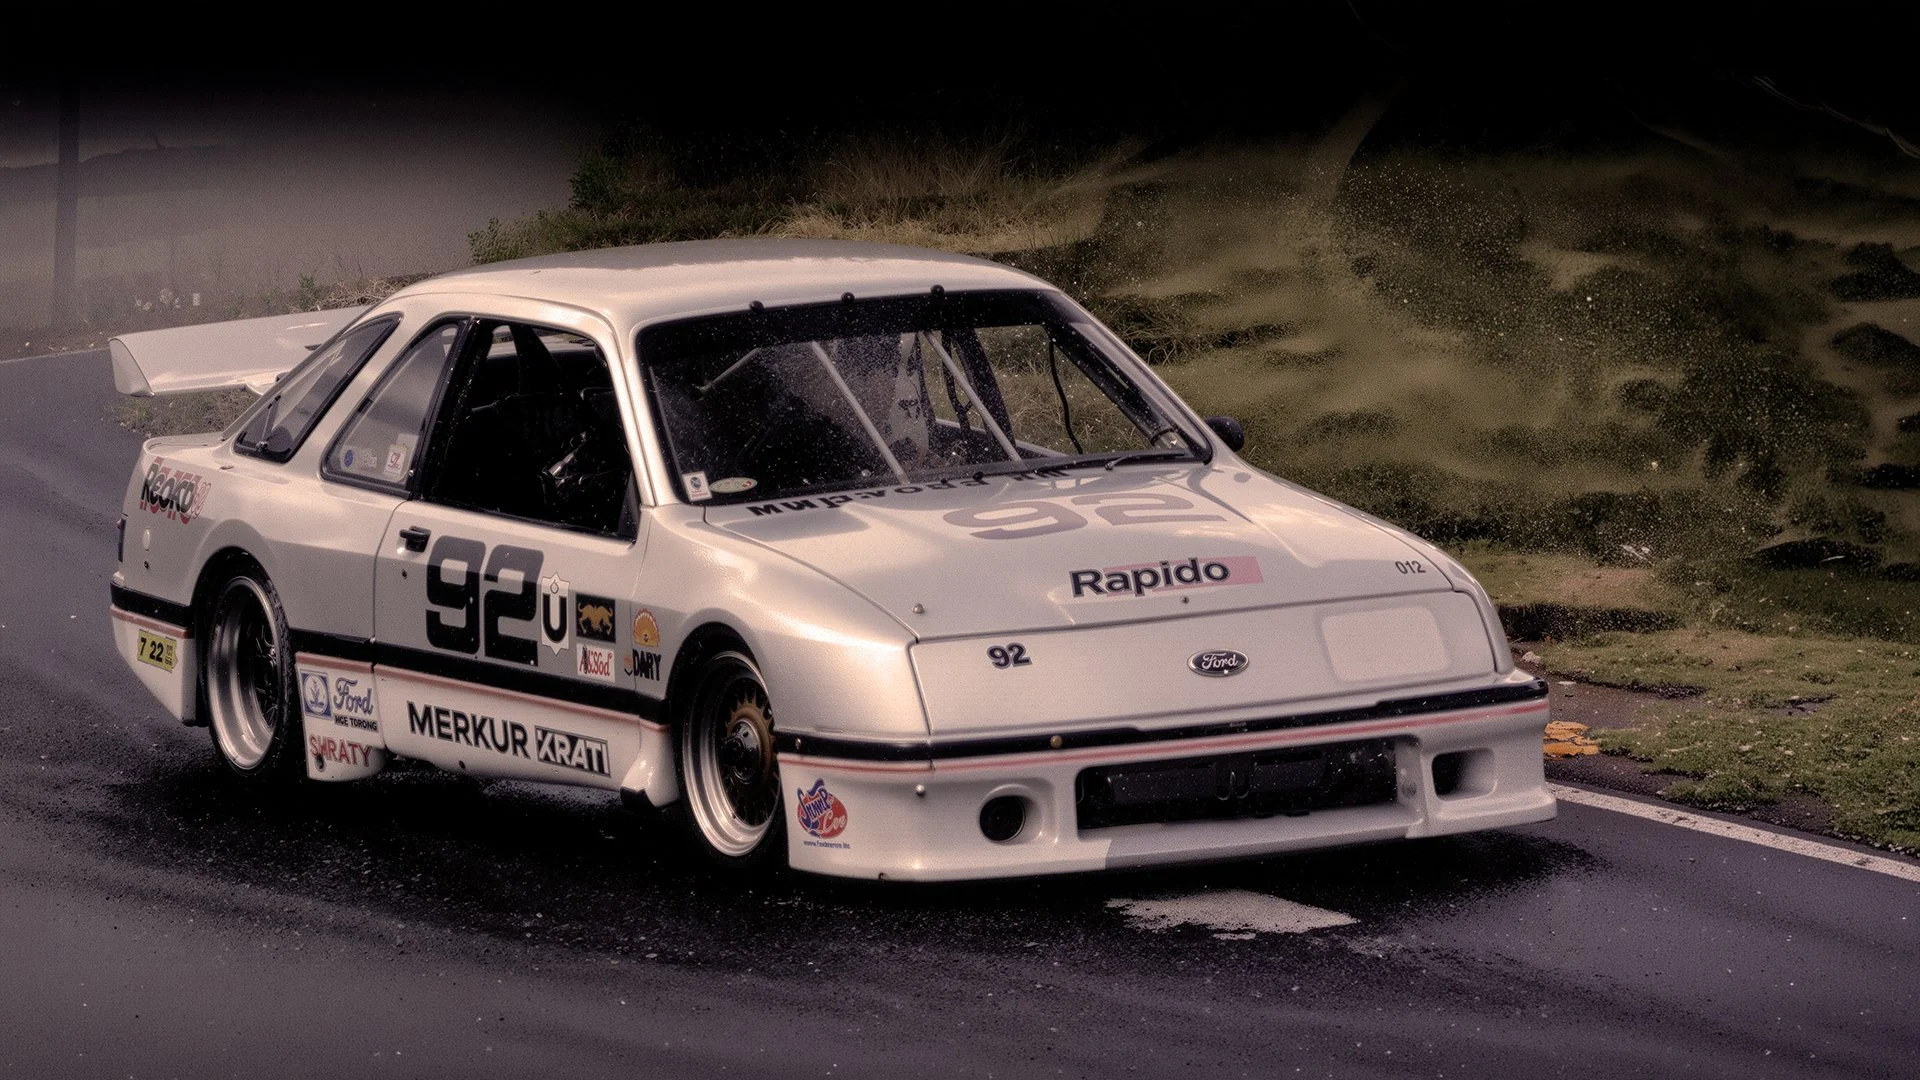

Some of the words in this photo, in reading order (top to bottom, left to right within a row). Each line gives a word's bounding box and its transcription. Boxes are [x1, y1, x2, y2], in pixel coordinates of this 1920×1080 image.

[943, 492, 1227, 540] 92
[1069, 557, 1230, 598] Rapido
[1395, 560, 1426, 575] 012
[425, 535, 544, 667] 92
[140, 636, 147, 656] 7
[149, 640, 164, 663] 22
[987, 643, 1032, 669] 92
[1201, 652, 1239, 669] Ford
[333, 677, 374, 716] Ford
[407, 700, 531, 760] MERKUR
